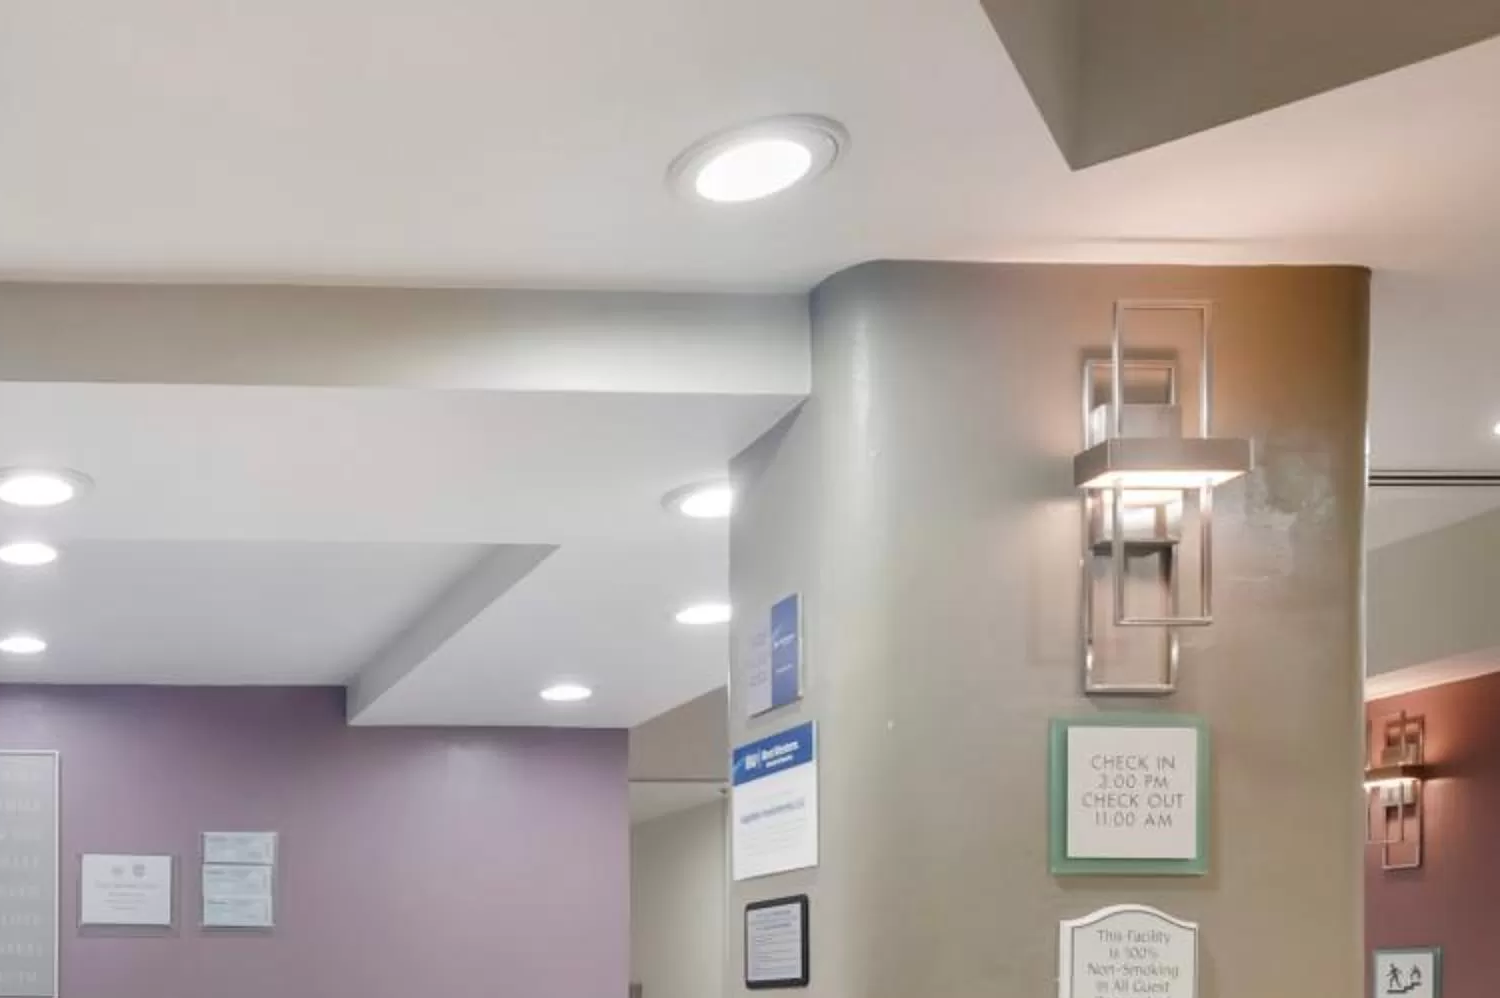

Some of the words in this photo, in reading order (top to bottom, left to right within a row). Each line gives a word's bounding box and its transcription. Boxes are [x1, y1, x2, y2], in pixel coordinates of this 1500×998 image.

[1091, 755, 1148, 770] CHECK
[1157, 755, 1176, 769] IN
[1143, 773, 1168, 789] PM
[1081, 791, 1139, 808] CHECK
[1147, 791, 1185, 809] OUT
[1145, 811, 1172, 828] AM
[1096, 929, 1122, 941] This
[1127, 929, 1171, 945] Facility
[1087, 962, 1179, 979] Non-Smoking
[1113, 979, 1129, 992] All
[1133, 980, 1171, 993] Guest
